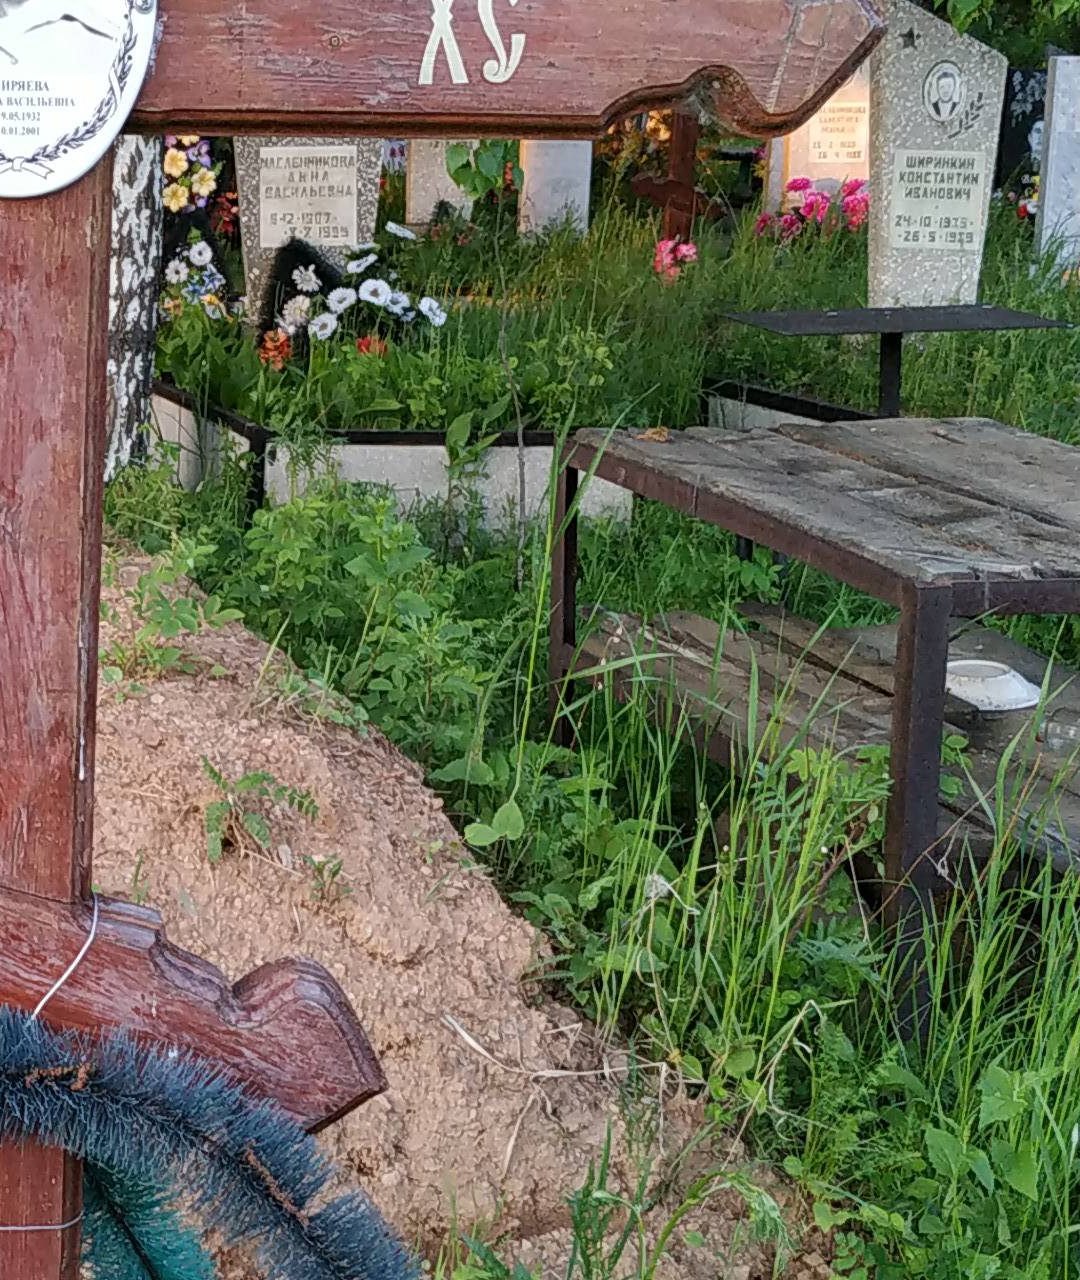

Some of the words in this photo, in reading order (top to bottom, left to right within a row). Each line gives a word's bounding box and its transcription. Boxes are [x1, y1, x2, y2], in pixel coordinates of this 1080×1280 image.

[7, 97, 75, 107] ВАСИЛЬЕВНА
[905, 156, 976, 170] ШИРИНКИН
[288, 171, 329, 182] АННА
[899, 171, 979, 185] КОНСТАНТИН
[265, 185, 353, 199] ВАСИЛЬЕВНА
[905, 186, 971, 200] ИВАНОВИЧ
